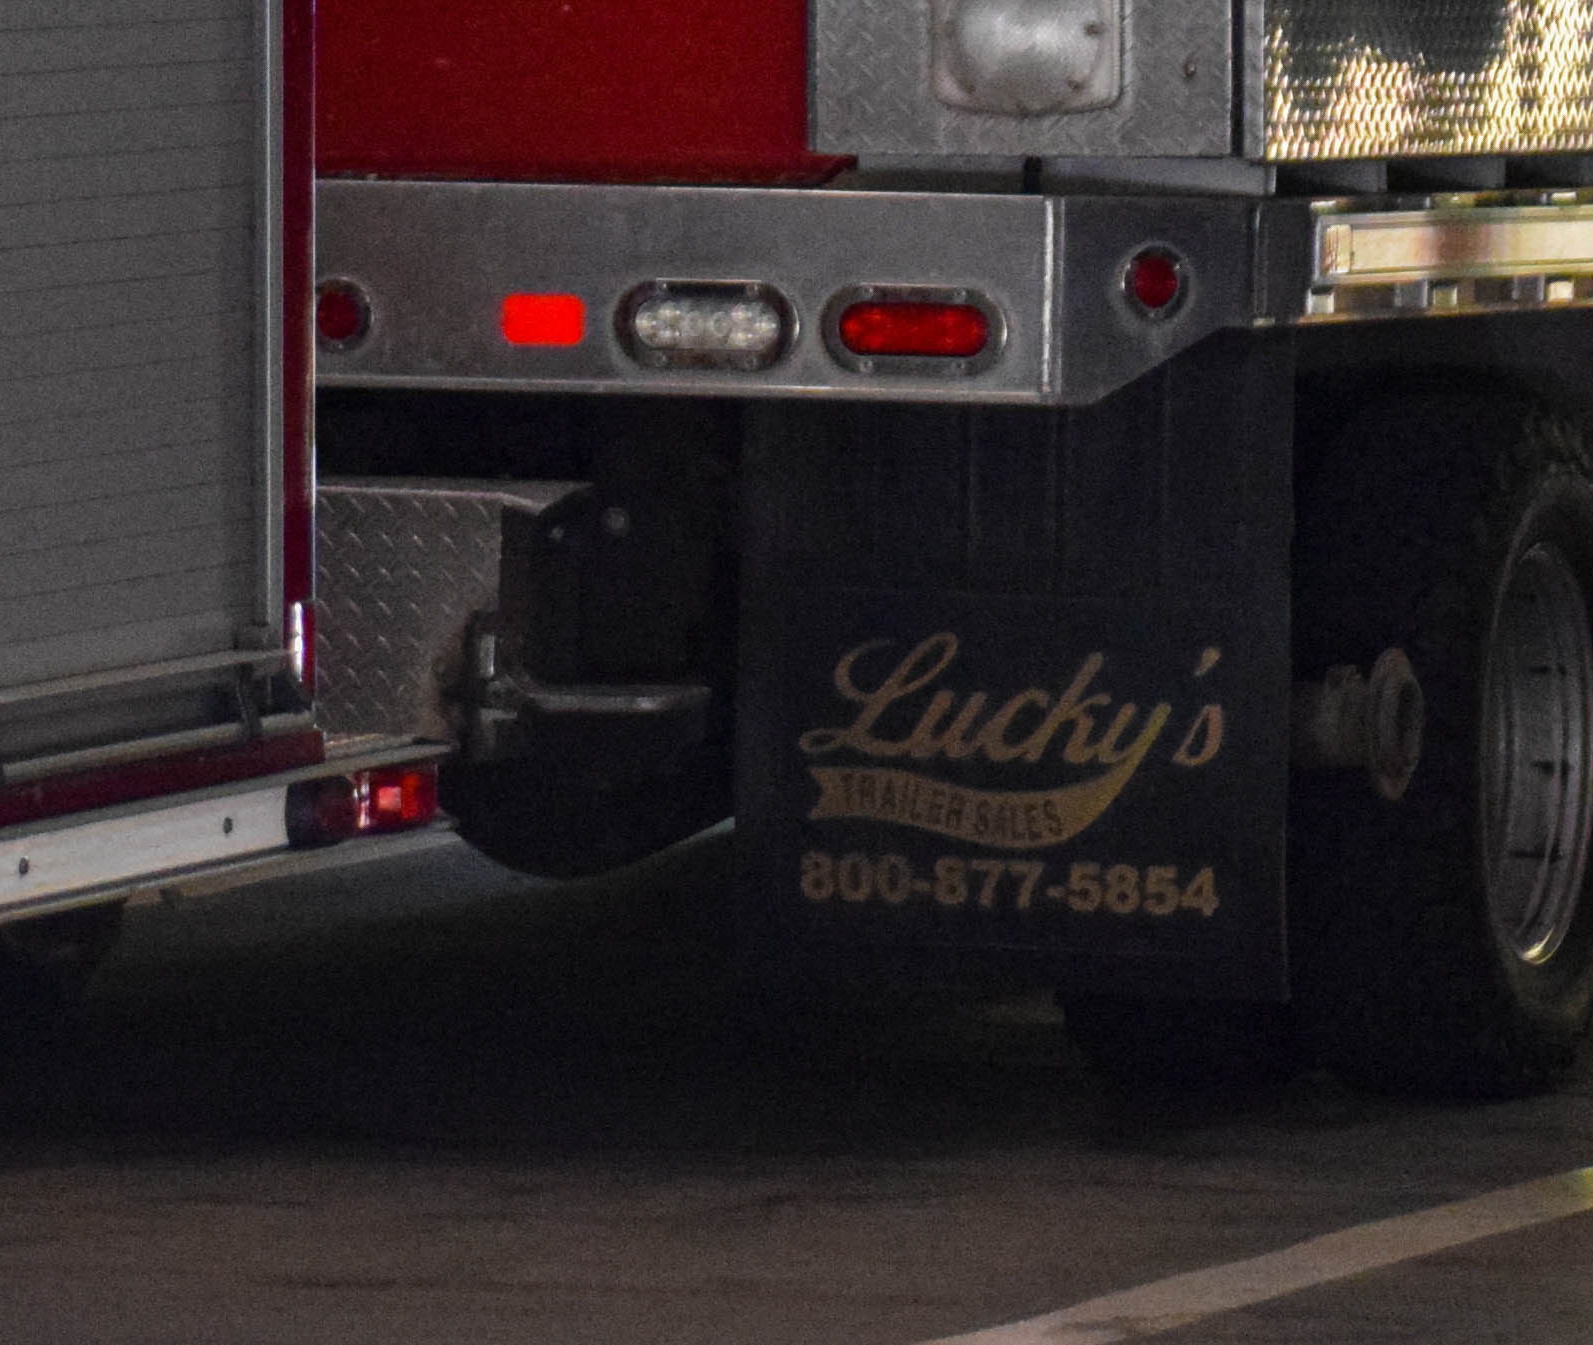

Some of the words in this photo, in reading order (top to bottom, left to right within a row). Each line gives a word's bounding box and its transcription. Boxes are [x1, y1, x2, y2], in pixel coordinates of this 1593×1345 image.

[798, 631, 1225, 769] Lucky's
[840, 771, 964, 832] TRAILER
[972, 798, 1066, 842] SALES
[799, 851, 1222, 918] 800-877-5854
